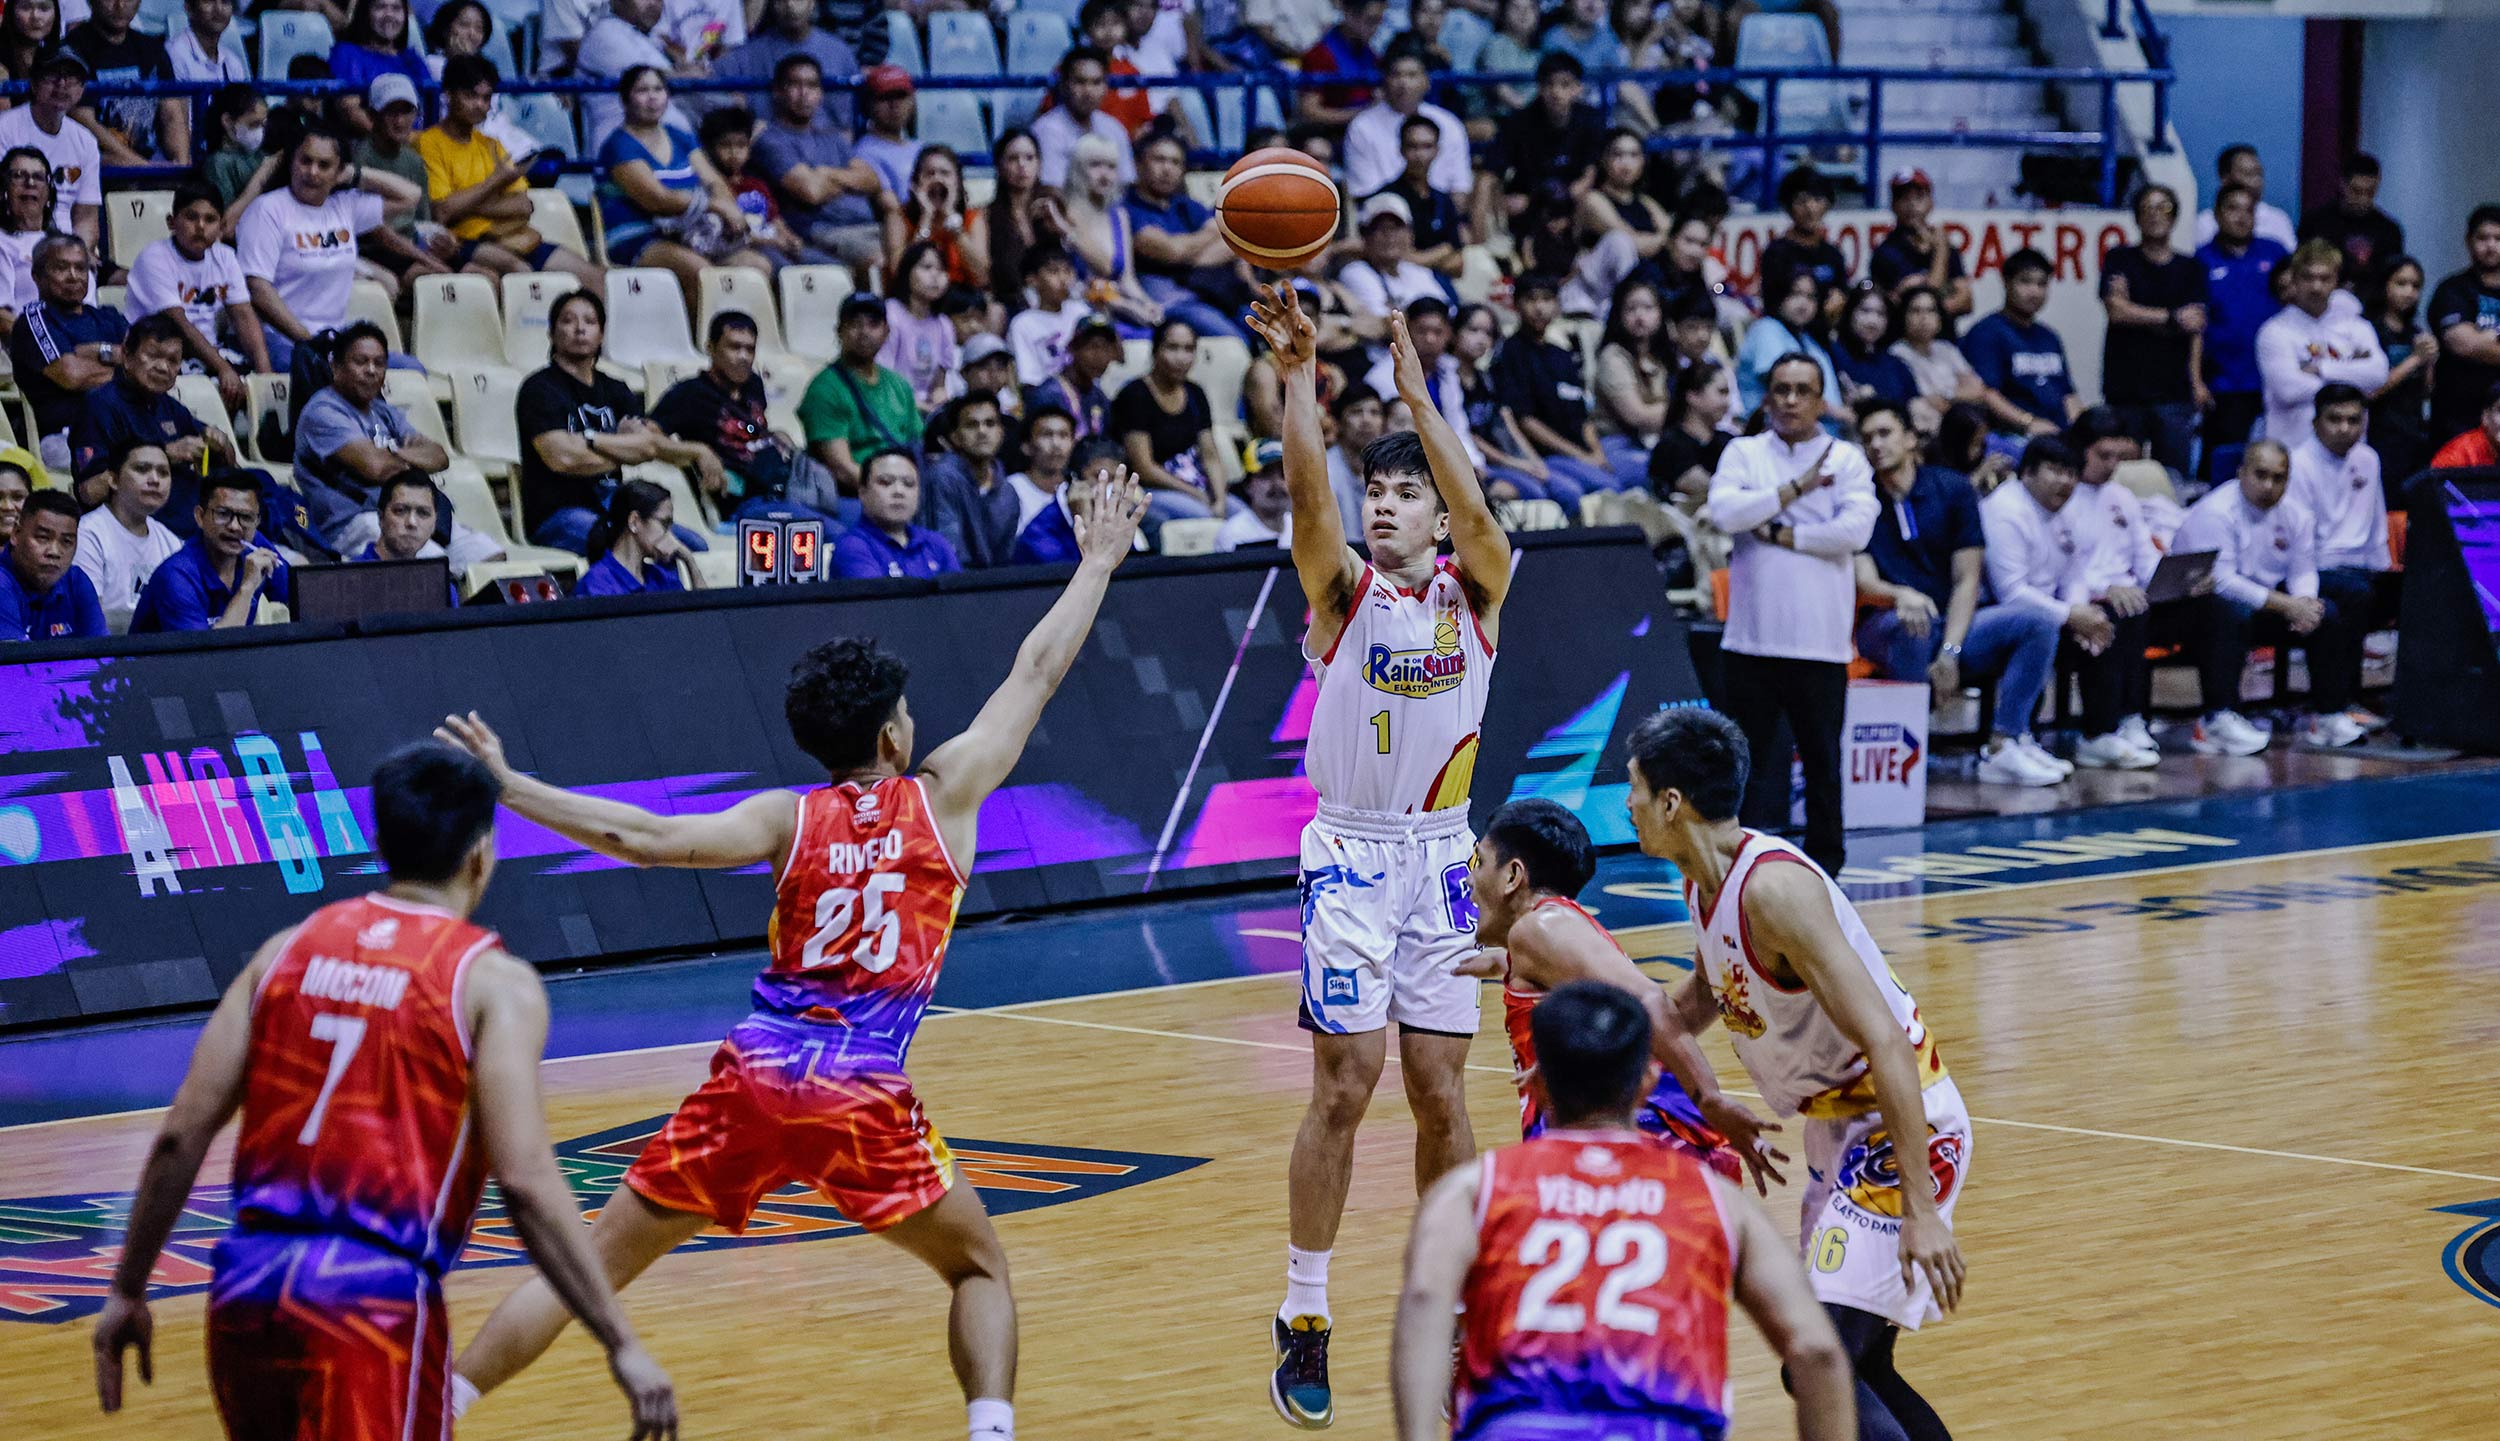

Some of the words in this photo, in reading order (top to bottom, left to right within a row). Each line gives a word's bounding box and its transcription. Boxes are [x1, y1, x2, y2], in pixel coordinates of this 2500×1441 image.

[130, 199, 146, 219] 17
[1368, 645, 1423, 685] Rain
[1411, 657, 1423, 665] OR
[1393, 683, 1430, 693] ELASTO
[1369, 710, 1391, 755] 1
[1852, 747, 1897, 783] LIVE
[801, 871, 907, 975] 25
[296, 1011, 369, 1147] 7
[1831, 1194, 1870, 1229] ELASTO
[1870, 1220, 1902, 1237] PAIN
[1514, 1219, 1668, 1336] 22
